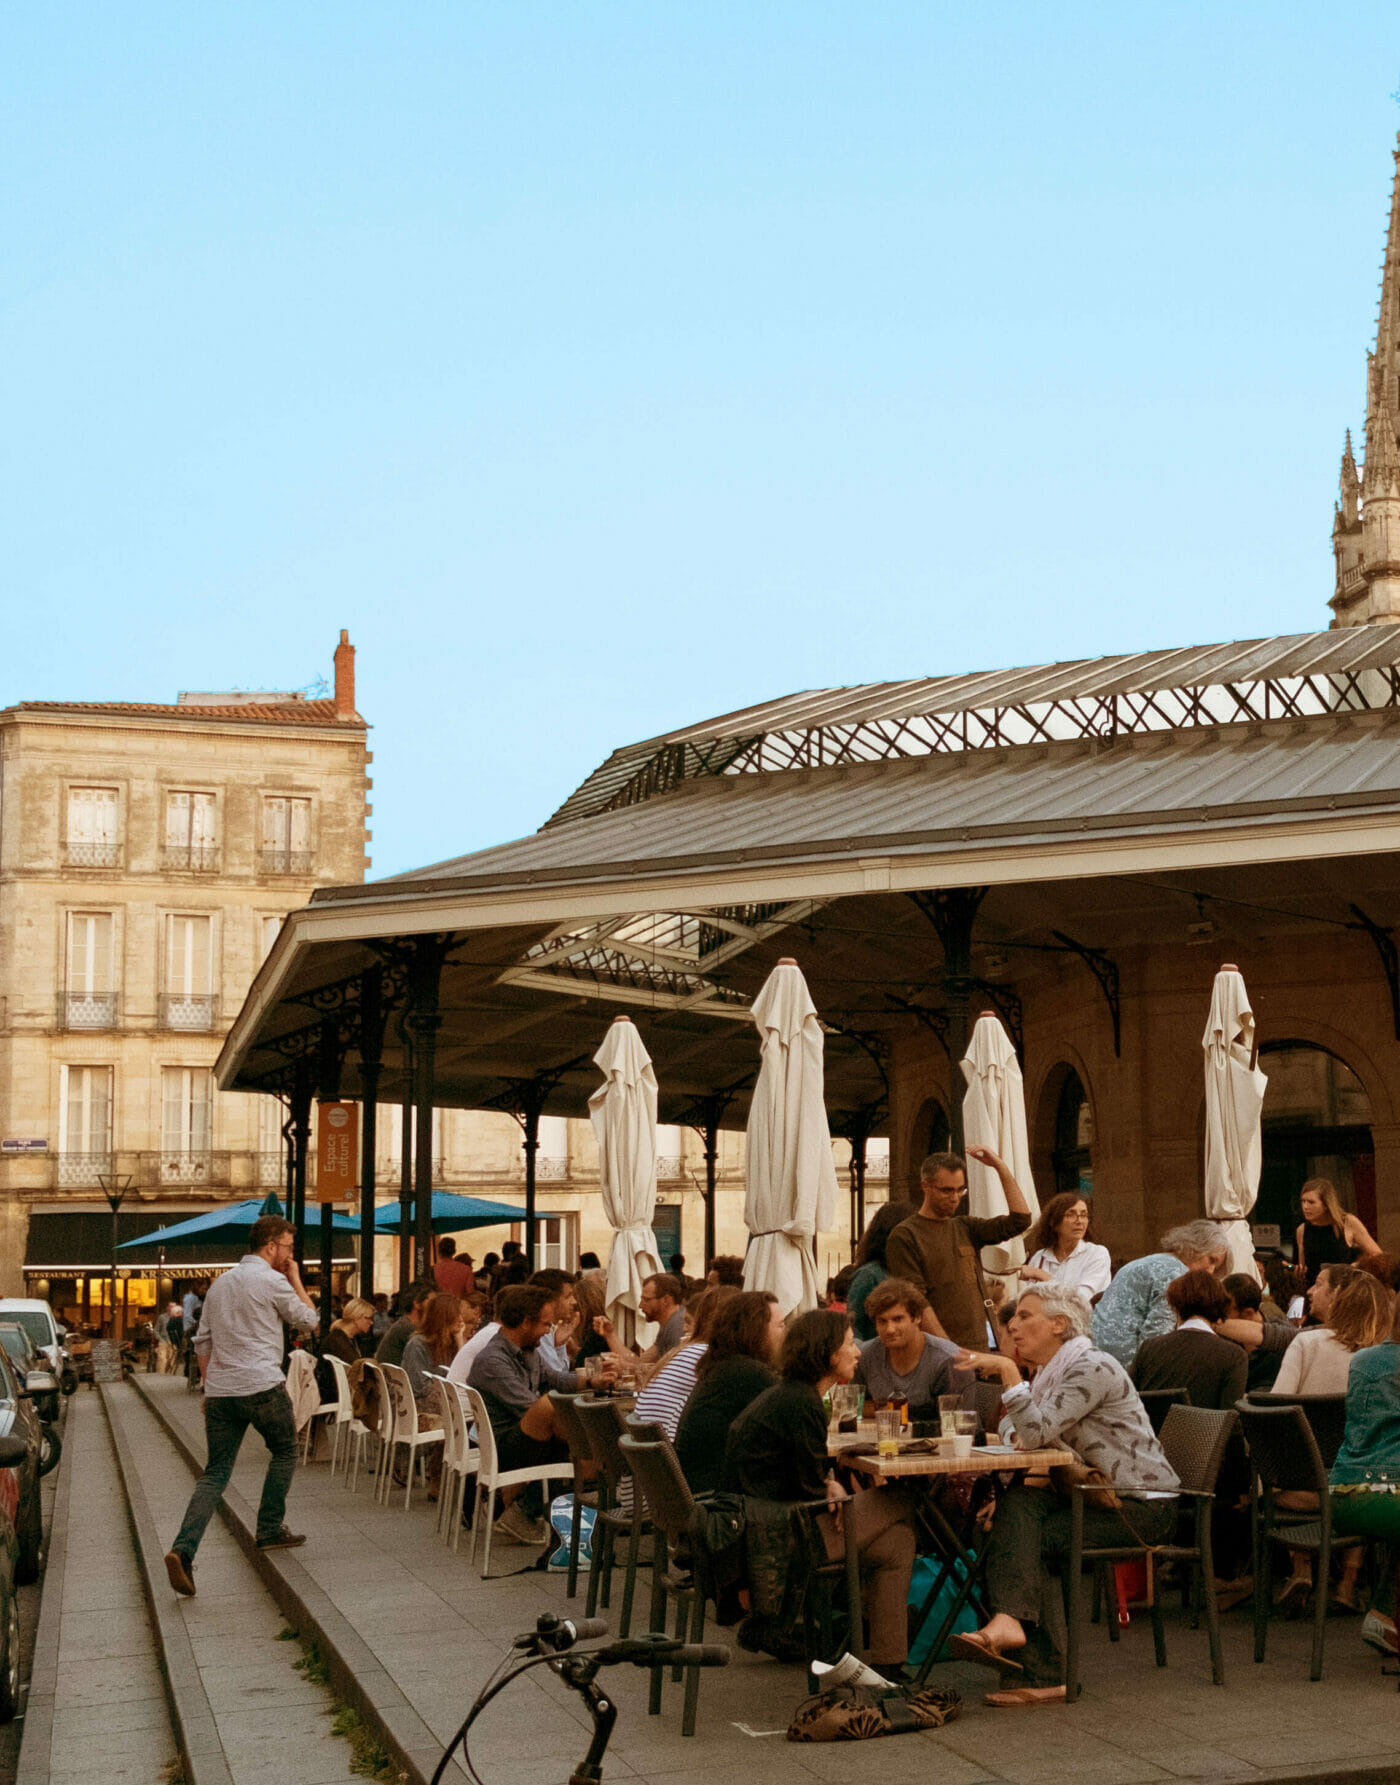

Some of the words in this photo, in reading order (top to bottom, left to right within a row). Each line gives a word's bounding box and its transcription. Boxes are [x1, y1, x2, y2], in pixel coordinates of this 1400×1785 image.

[323, 1133, 338, 1172] Espace
[338, 1133, 350, 1177] culturel
[28, 1271, 86, 1279] RESTAURANT
